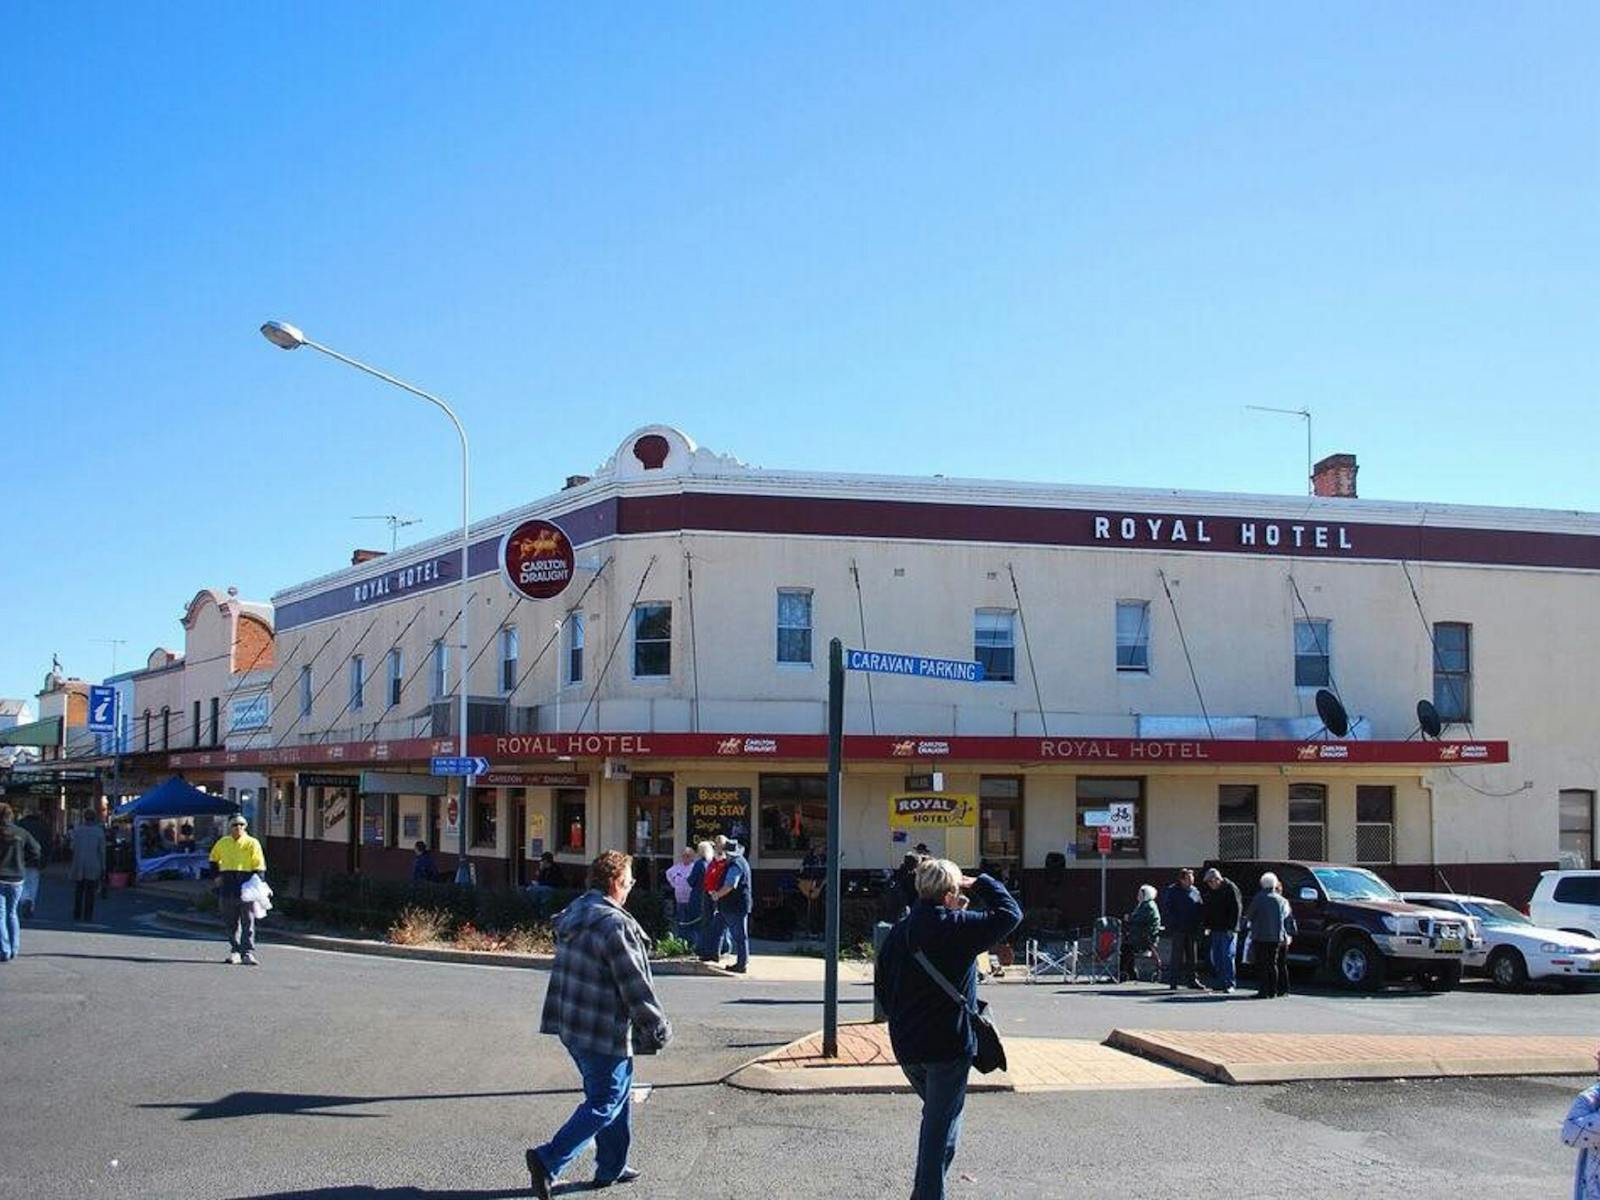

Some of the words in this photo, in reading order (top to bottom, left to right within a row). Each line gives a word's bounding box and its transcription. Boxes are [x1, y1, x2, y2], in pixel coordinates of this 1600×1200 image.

[1094, 516, 1211, 542] ROYAL
[1241, 523, 1352, 549] HOTEL
[521, 559, 566, 572] CARLTON
[354, 577, 390, 602] ROYAL
[398, 560, 439, 589] HOTEL
[520, 569, 569, 584] DRAUGHT
[851, 651, 914, 673] CARAVAN
[919, 660, 976, 680] PARKING
[496, 737, 557, 754] ROYAL
[568, 735, 650, 753] HOTEL
[1041, 741, 1118, 757] ROYAL
[1130, 742, 1208, 758] HOTEL
[699, 789, 738, 804] Budget
[693, 804, 717, 816] PUB
[719, 804, 748, 816] STAY
[899, 799, 951, 811] ROYAL
[913, 815, 949, 823] HOTEL
